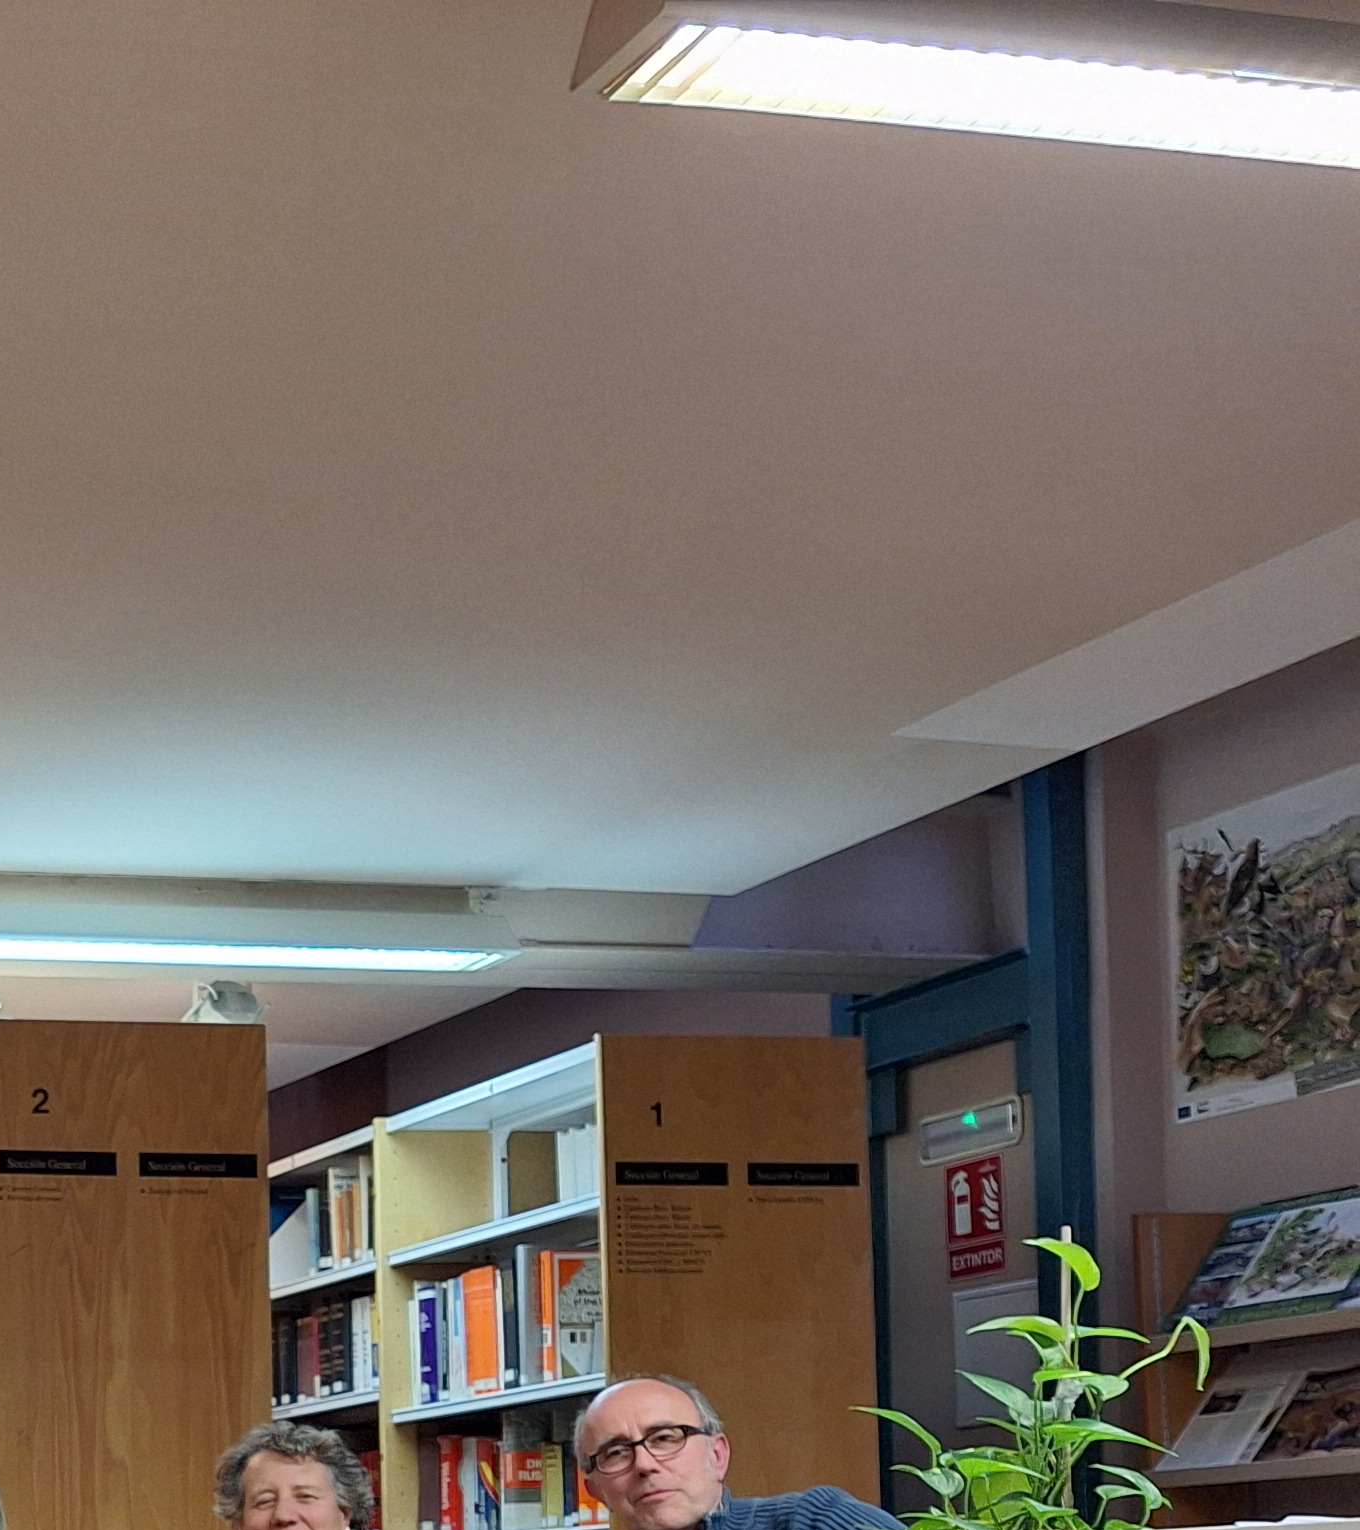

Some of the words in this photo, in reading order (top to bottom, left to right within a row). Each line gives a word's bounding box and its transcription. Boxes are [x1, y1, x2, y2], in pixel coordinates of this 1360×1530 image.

[32, 1089, 49, 1114] 2
[650, 1102, 662, 1127] 1
[952, 1246, 1003, 1272] EXTINTOR
